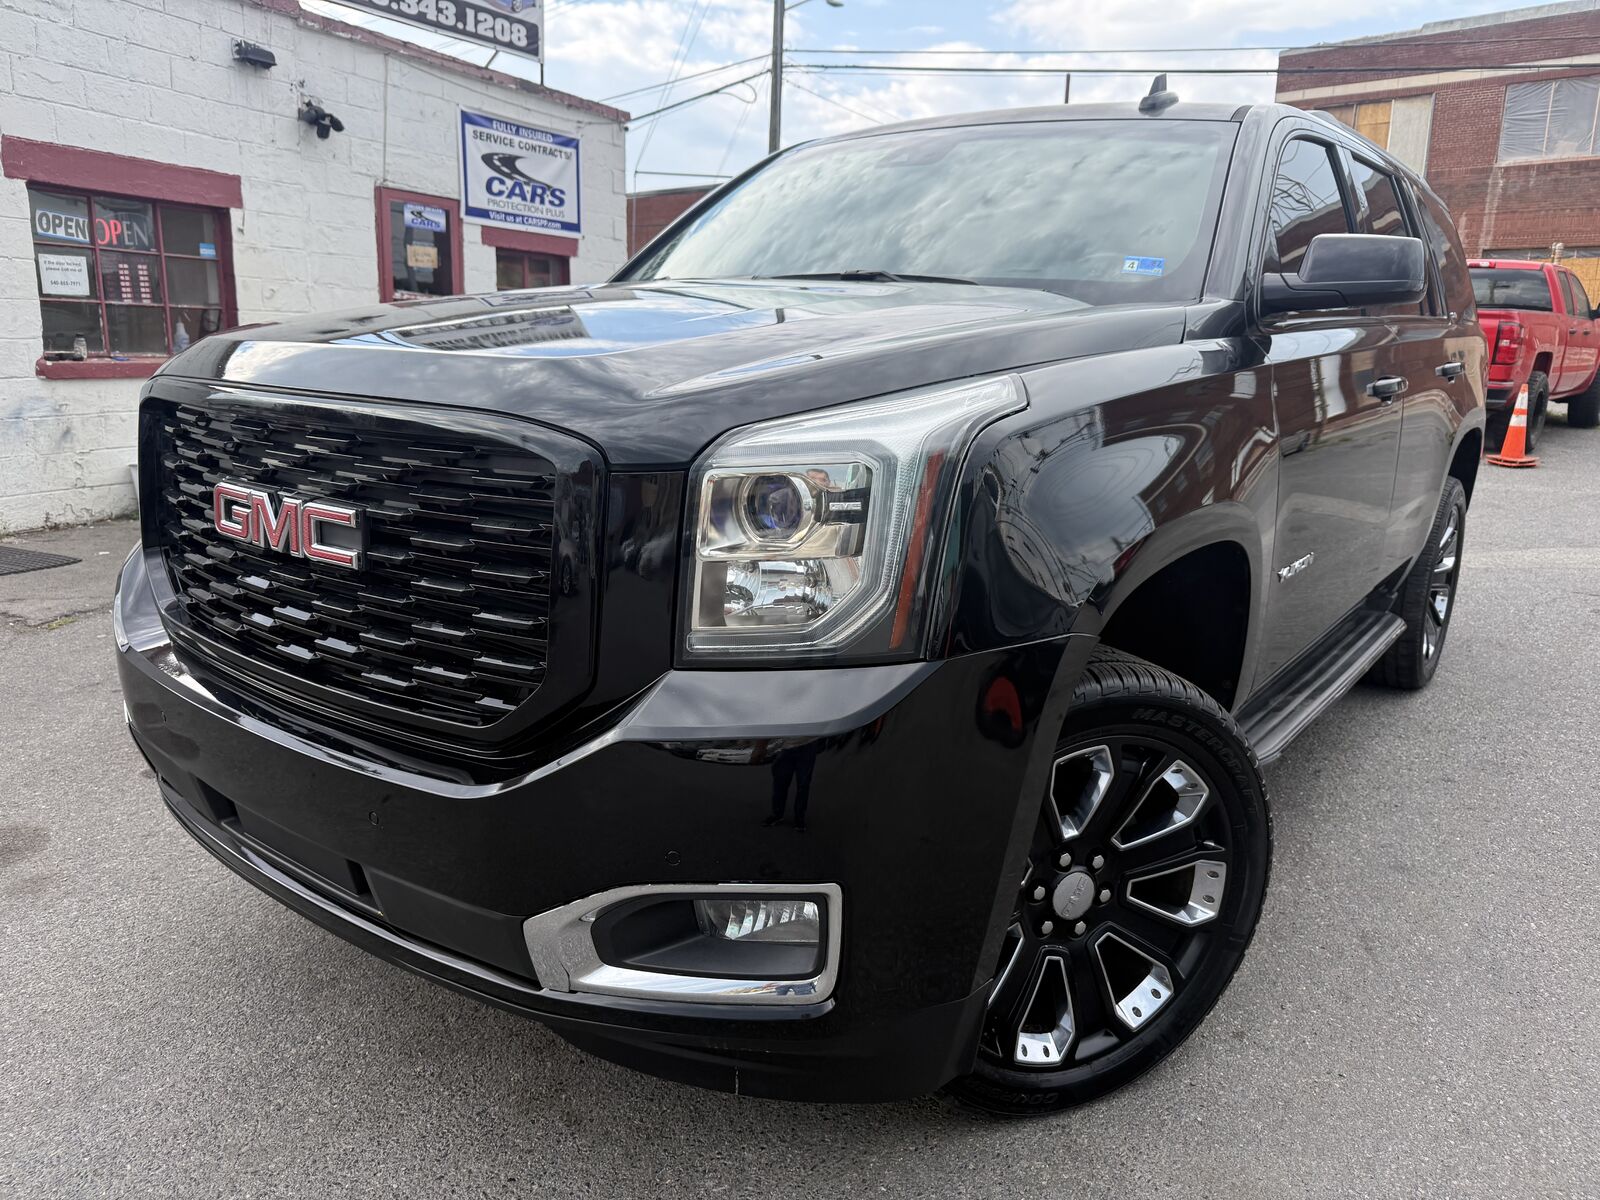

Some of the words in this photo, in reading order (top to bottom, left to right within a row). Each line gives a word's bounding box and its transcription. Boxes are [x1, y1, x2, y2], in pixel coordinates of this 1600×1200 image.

[472, 130, 516, 148] SERVICE
[492, 120, 517, 135] FULLY
[519, 127, 553, 142] INSURED
[487, 198, 544, 216] PROTECTION
[545, 207, 565, 218] PLUS
[488, 211, 505, 220] Visit
[515, 216, 523, 224] at
[37, 212, 88, 241] OPEN
[96, 218, 149, 247] OPEN
[411, 218, 440, 229] CARS
[1127, 261, 1136, 269] 4
[829, 501, 862, 511] GMC
[213, 481, 358, 571] GMC
[1131, 706, 1259, 815] MASTERCRAFT
